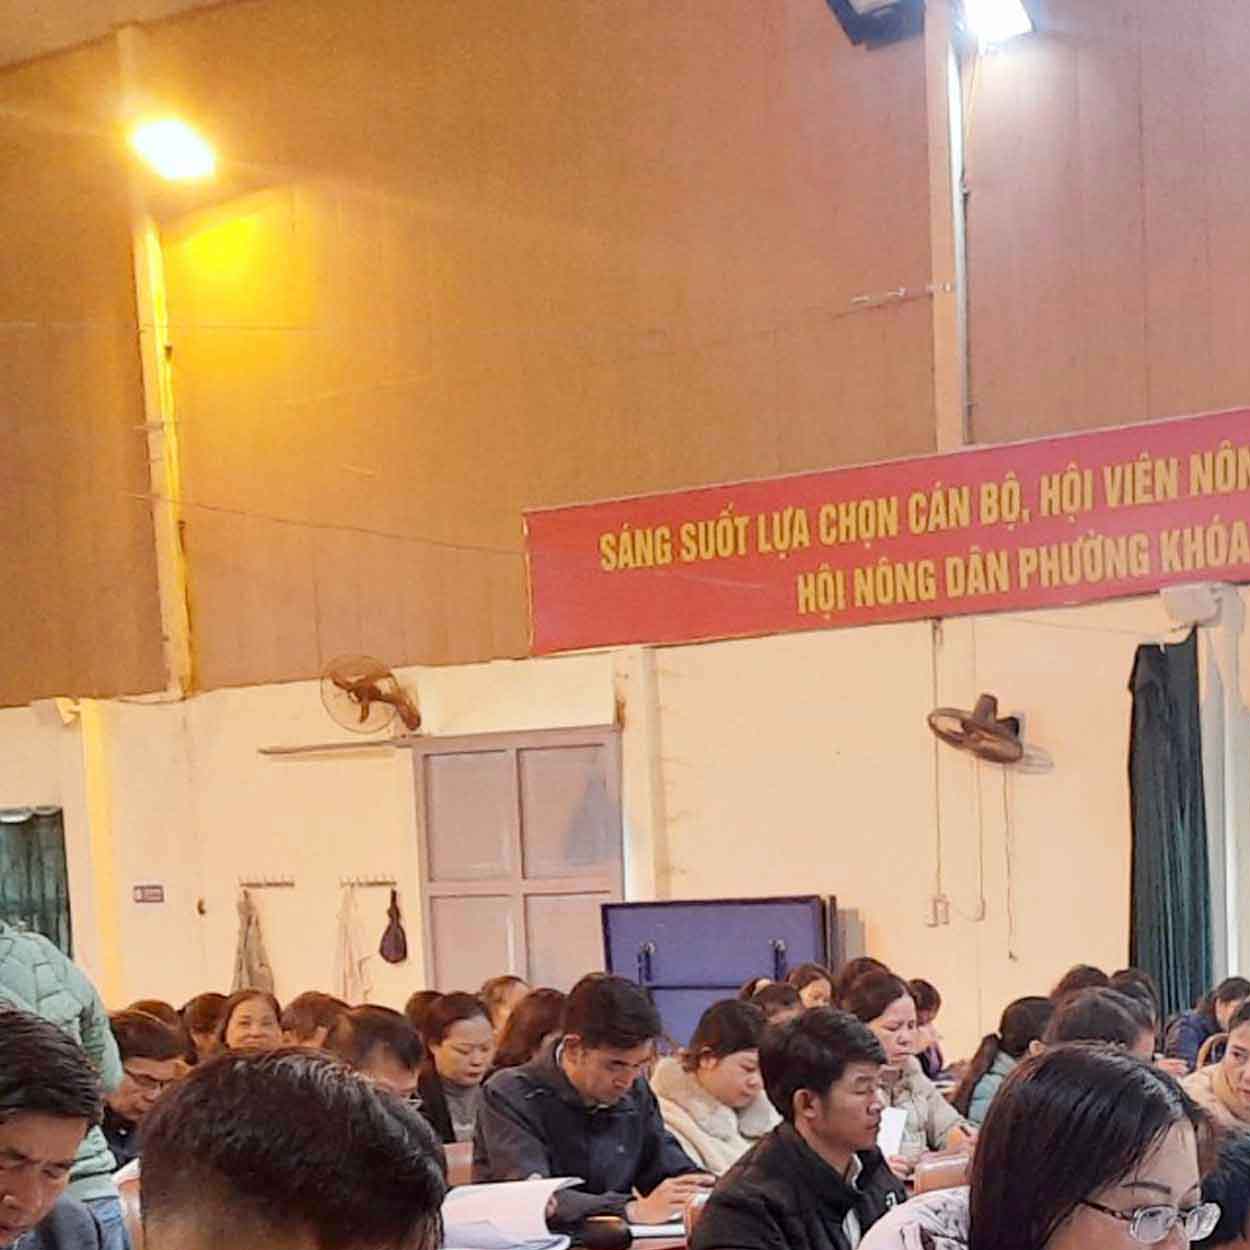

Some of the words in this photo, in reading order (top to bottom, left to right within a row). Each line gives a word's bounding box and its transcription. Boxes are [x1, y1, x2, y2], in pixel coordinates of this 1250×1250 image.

[600, 523, 673, 571] SÁNG
[680, 502, 750, 563] SUỐT
[757, 506, 811, 560] LỰA
[819, 497, 899, 549] CHỌN
[908, 480, 971, 534] CÁN
[1040, 461, 1093, 523] HỘI
[1103, 450, 1178, 507] VIÊN
[797, 563, 846, 620] HỘI
[854, 556, 937, 606] NÔNG
[944, 545, 1010, 598] DÂN
[1018, 529, 1150, 589] PHƯỜNG
[1159, 514, 1250, 573] KHÓA
